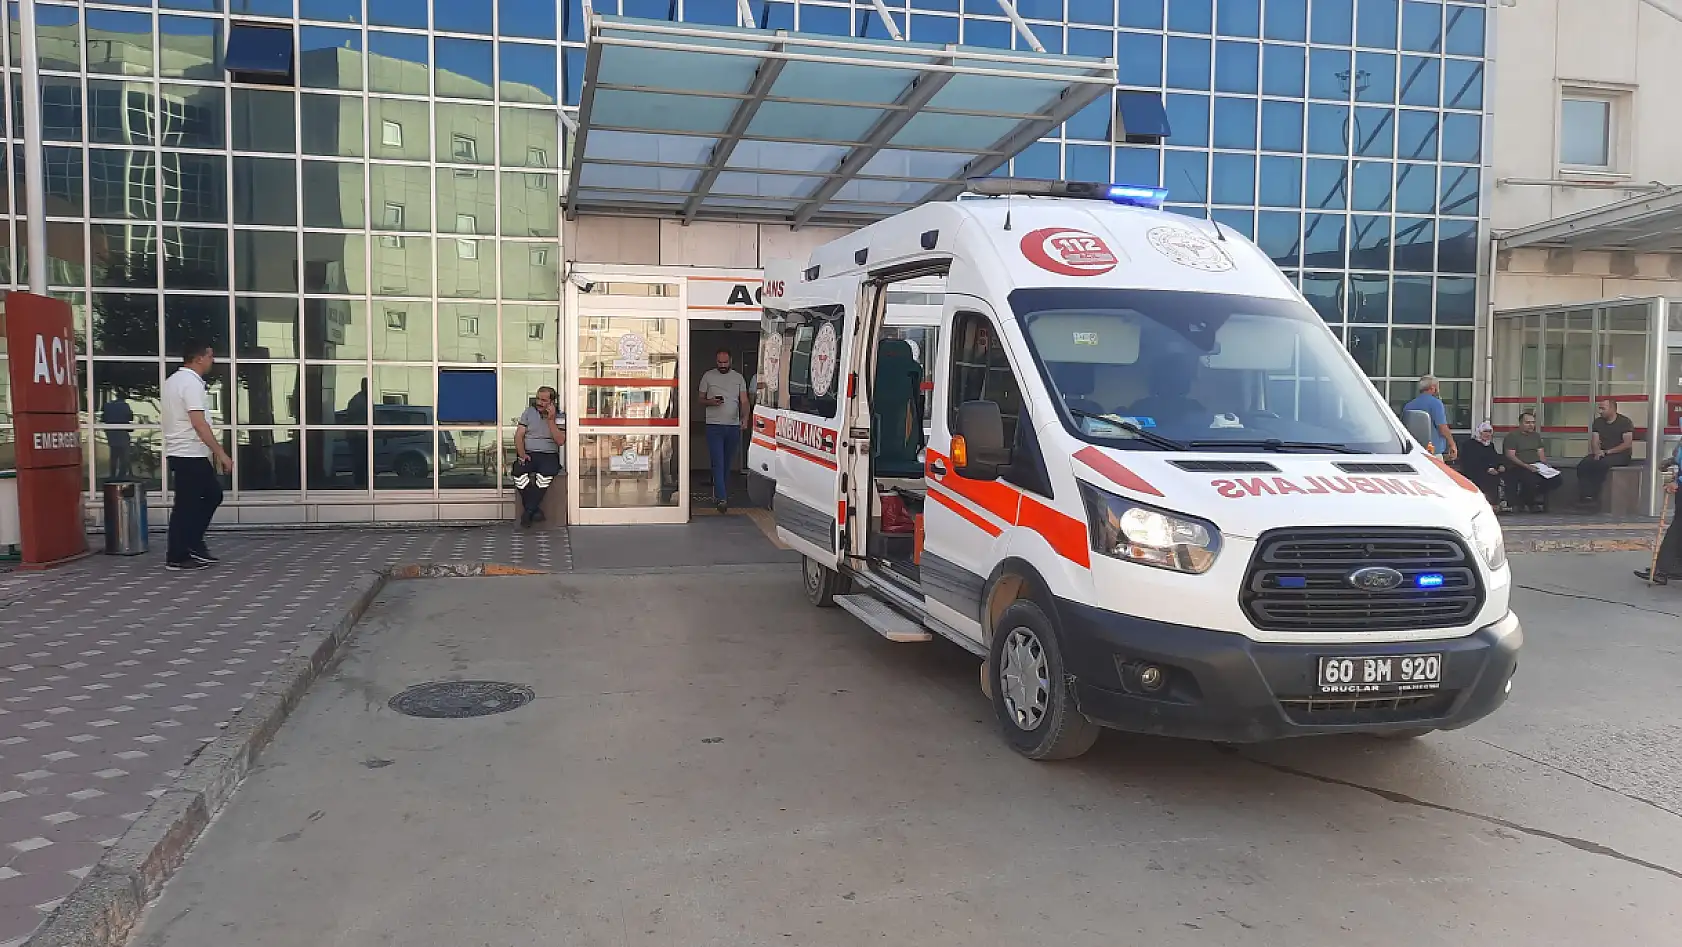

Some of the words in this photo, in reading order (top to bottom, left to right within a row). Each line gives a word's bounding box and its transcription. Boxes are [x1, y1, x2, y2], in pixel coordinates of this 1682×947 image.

[1057, 238, 1101, 252] 112
[727, 284, 761, 305] A
[1363, 571, 1393, 586] Ford
[1325, 659, 1353, 682] 60
[1363, 659, 1391, 682] BM
[1401, 656, 1437, 680] 920
